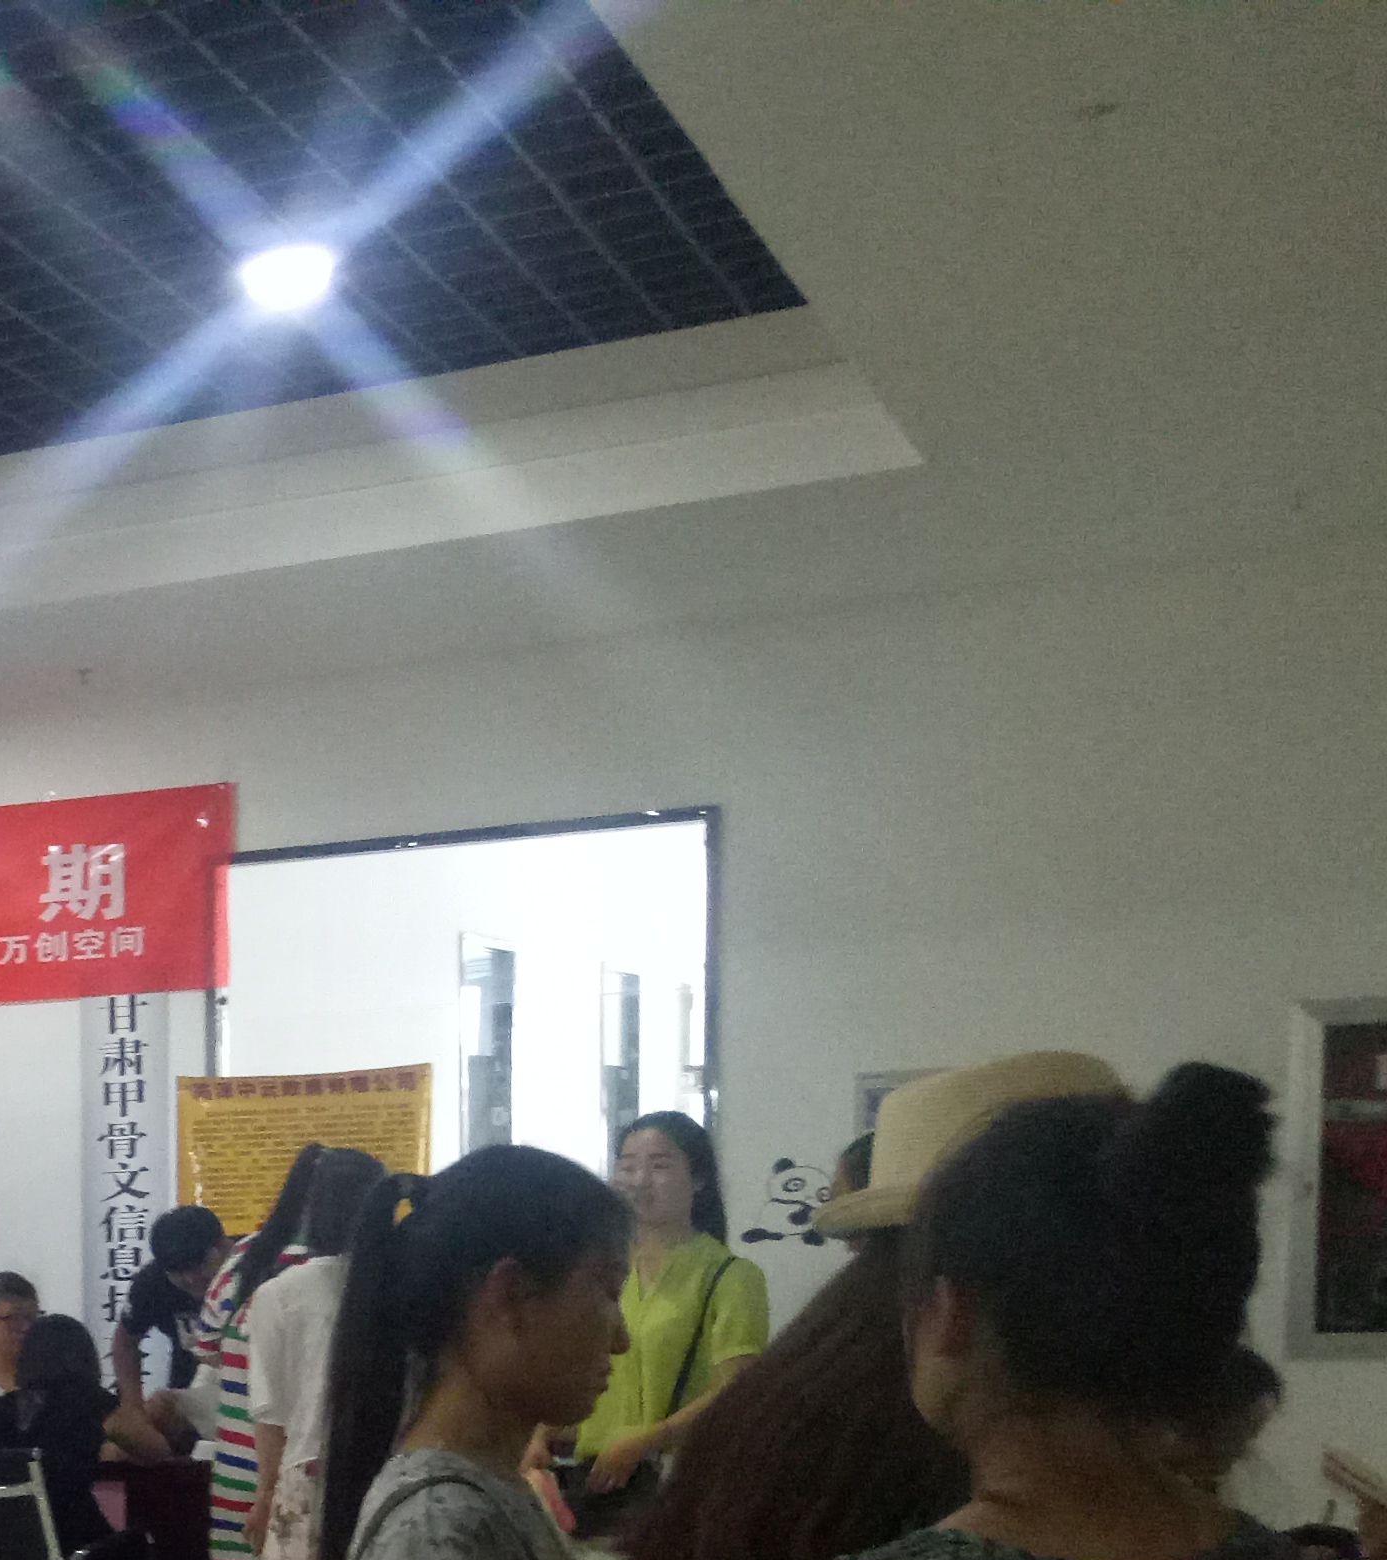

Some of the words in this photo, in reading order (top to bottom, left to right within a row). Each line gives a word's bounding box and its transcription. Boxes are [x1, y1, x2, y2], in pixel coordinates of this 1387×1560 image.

[98, 994, 151, 1397] 甘肃甲骨文信息
